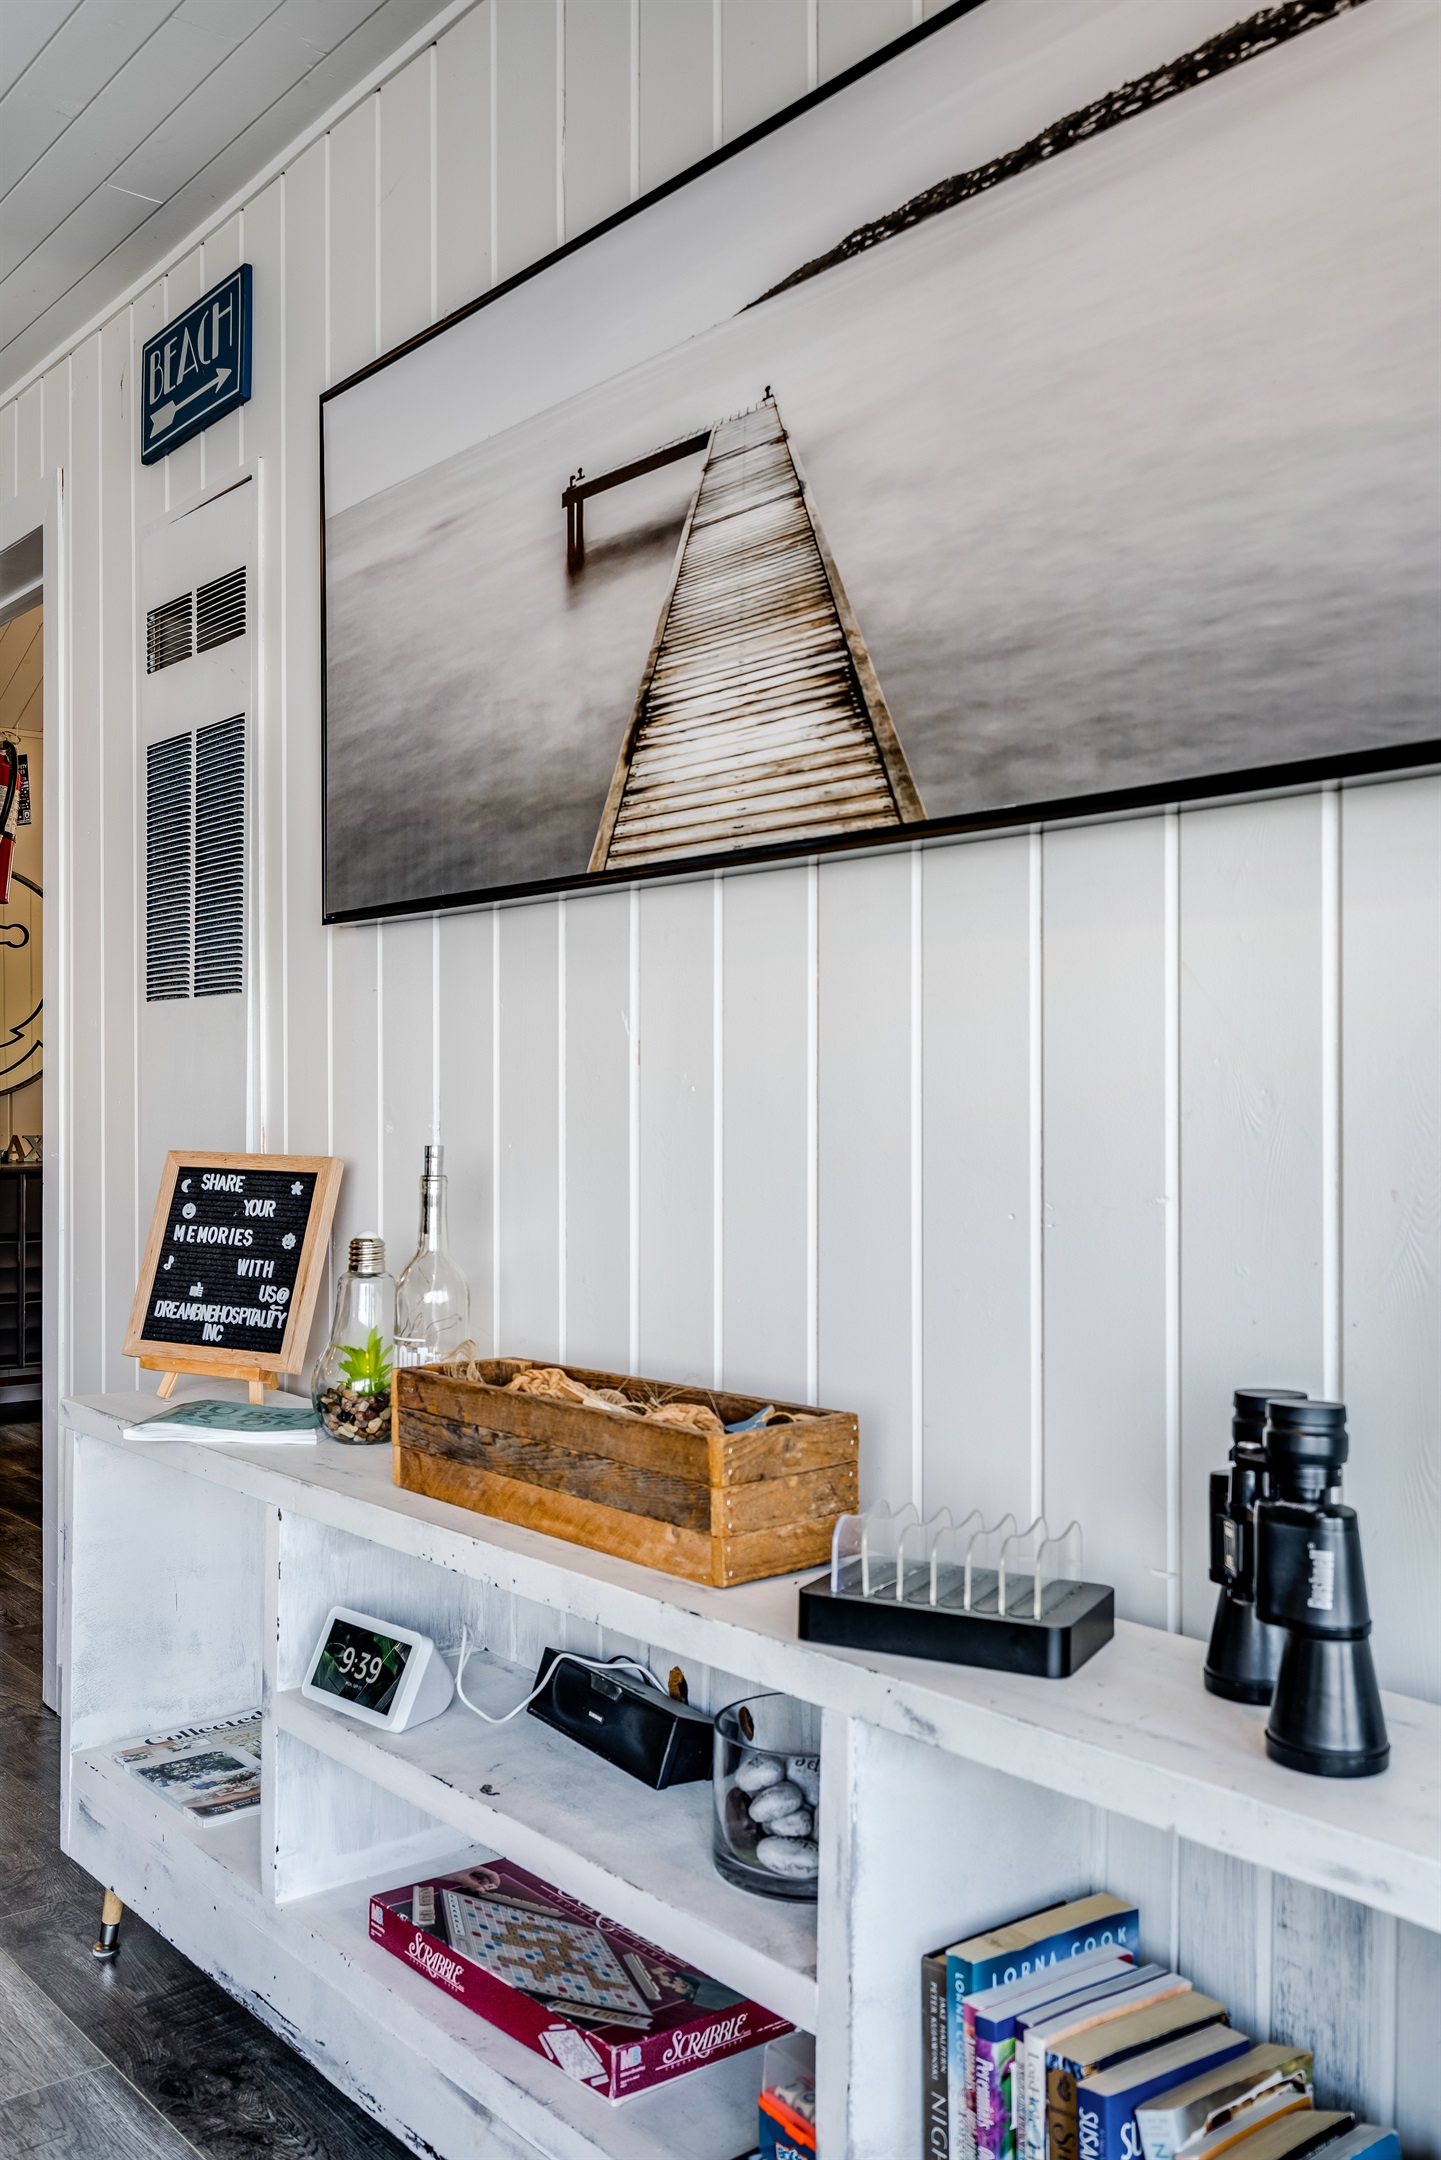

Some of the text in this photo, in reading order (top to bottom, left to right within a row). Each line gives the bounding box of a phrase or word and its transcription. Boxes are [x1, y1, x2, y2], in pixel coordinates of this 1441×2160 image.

[149, 292, 233, 405] BEACH
[201, 1173, 246, 1194] SHARE
[243, 1199, 277, 1218] YOUR
[173, 1224, 254, 1247] MEMORIES
[236, 1258, 275, 1279] WITH
[258, 1284, 290, 1303] US@
[201, 1323, 225, 1343] INC
[339, 1646, 383, 1684] 9:39
[144, 1710, 263, 1746] Collected
[1070, 1926, 1127, 1957] COOK
[408, 1931, 465, 1986] SCRABBLE
[662, 2013, 747, 2065] SCRABBLE
[620, 2045, 642, 2071] MB
